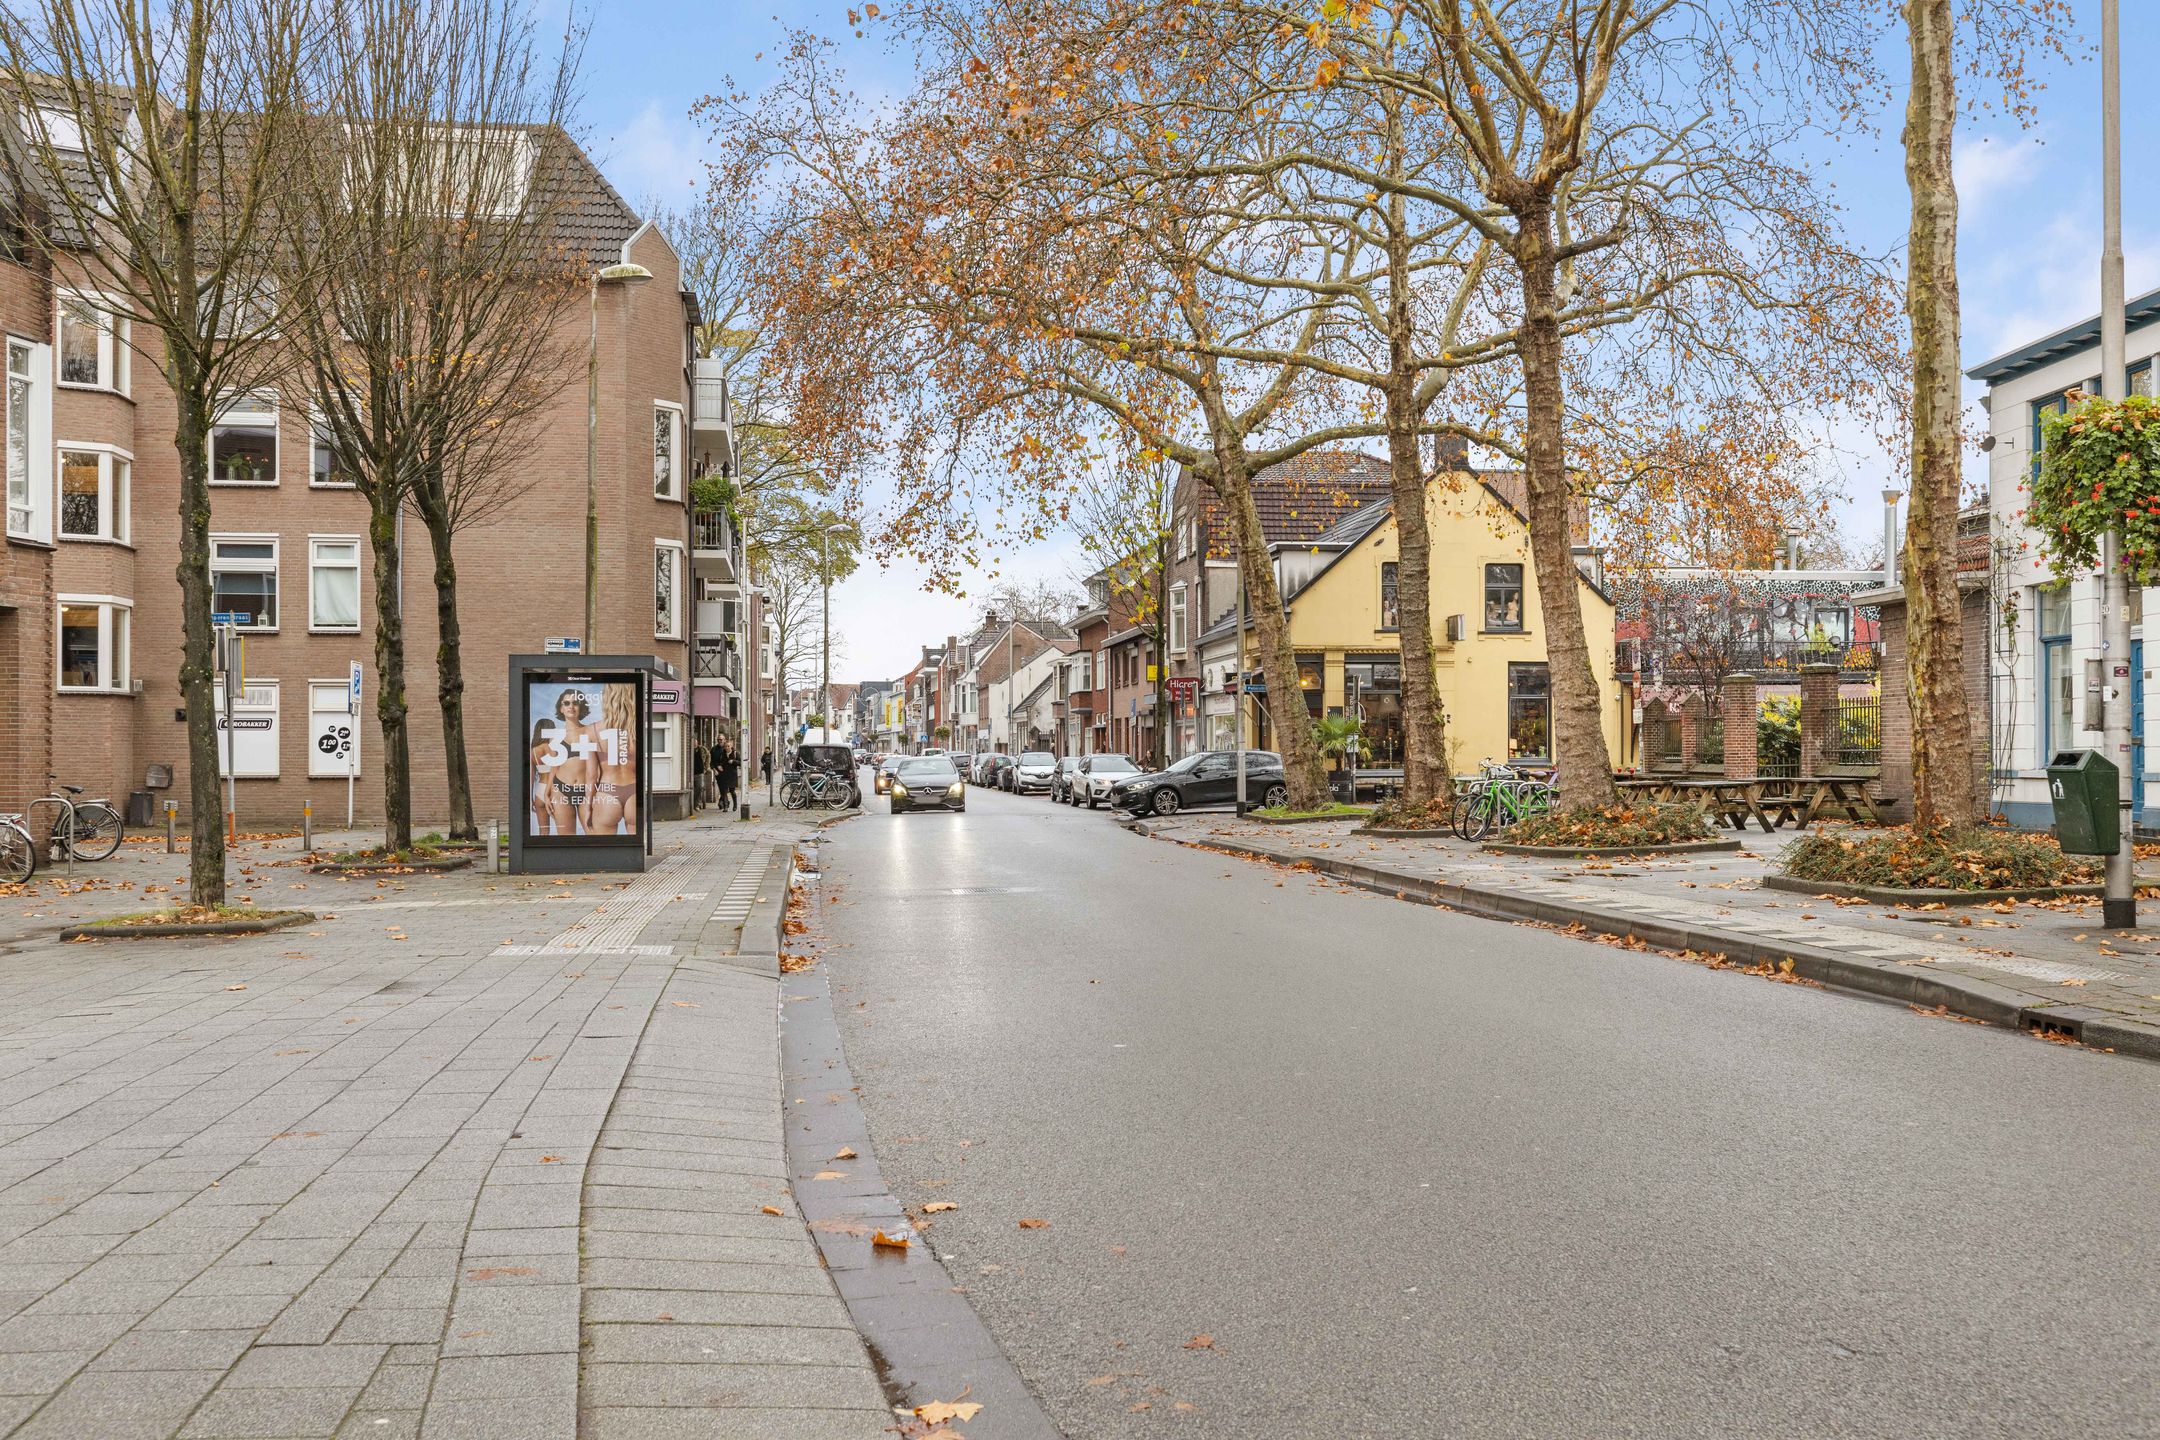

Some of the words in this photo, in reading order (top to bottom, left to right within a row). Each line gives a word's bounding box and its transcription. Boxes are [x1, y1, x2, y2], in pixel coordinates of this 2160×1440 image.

[540, 728, 619, 767] 3+1
[619, 730, 628, 765] GRATIS
[553, 783, 559, 792] 3
[561, 783, 571, 792] IS
[573, 783, 592, 792] EEN
[594, 783, 617, 792] VIBE
[550, 796, 557, 804] 4
[560, 796, 569, 804] IS
[571, 796, 590, 804] EEN
[592, 796, 619, 804] HYPE
